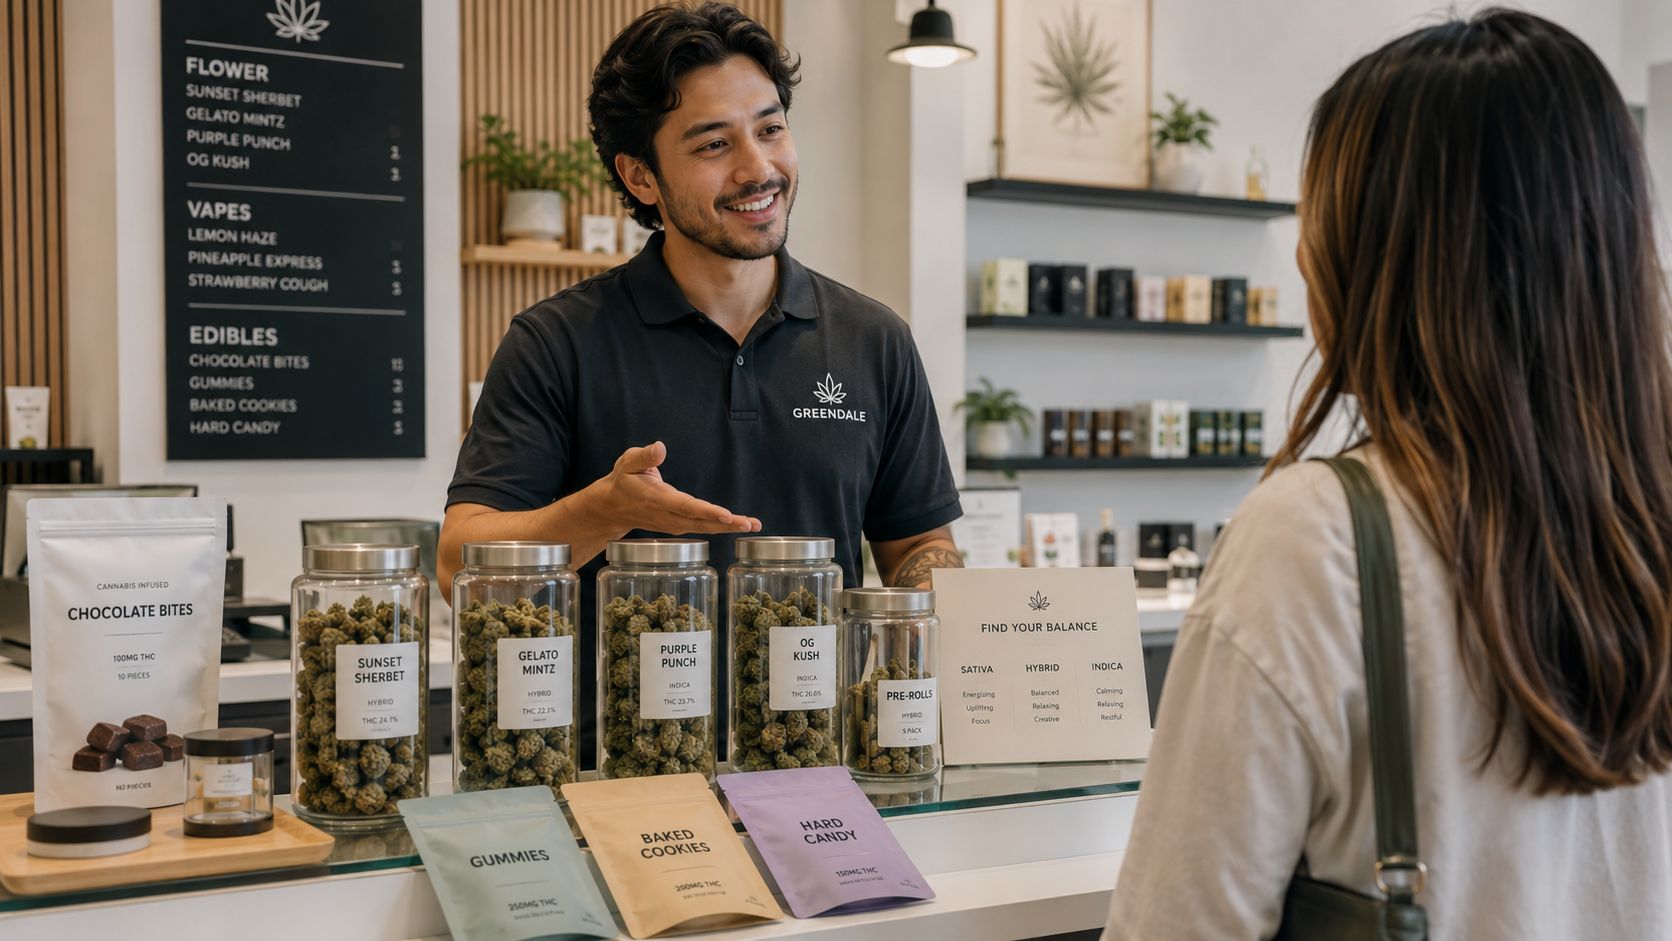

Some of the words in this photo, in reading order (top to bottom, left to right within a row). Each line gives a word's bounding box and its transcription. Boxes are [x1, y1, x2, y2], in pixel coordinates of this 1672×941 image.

[186, 57, 269, 82] FLOWER
[186, 84, 239, 101] SUNSET
[242, 89, 302, 107] SHERBET
[186, 106, 239, 124] GELATO
[243, 113, 285, 128] MINTZ
[187, 130, 239, 146] PURPLE
[243, 134, 291, 150] PUNCH
[187, 152, 209, 167] OG
[212, 155, 250, 169] KUSH
[187, 200, 251, 221] VAPES
[188, 228, 237, 243] LEMON
[241, 231, 277, 246] HAZE
[189, 251, 262, 267] PINEAPPLE
[266, 255, 323, 270] EXPRESS
[188, 274, 276, 290] STRAWBERRY
[280, 277, 328, 292] COUGH
[189, 326, 278, 346] EDIBLES
[189, 354, 270, 368] CHOCOLATE
[274, 355, 309, 369] BITES
[189, 376, 254, 390] GUMMIES
[190, 399, 235, 412] BAKED
[238, 399, 297, 412] COOKIES
[793, 408, 866, 422] GREENDALE
[190, 421, 229, 433] HARD
[232, 421, 281, 434] CANDY
[97, 582, 136, 591] CANNABIS
[138, 580, 169, 589] INFUSED
[68, 604, 156, 621] CHOCOLATE
[159, 602, 193, 617] BITES
[981, 623, 1008, 633] FIND
[1012, 623, 1042, 632] YOUR
[1047, 621, 1098, 632] BALANCE
[660, 643, 697, 655] PURPLE
[800, 638, 815, 649] OG
[113, 654, 138, 662] 100MG
[518, 649, 559, 662] GELATO
[793, 650, 820, 661] KUSH
[358, 656, 402, 669] SUNSET
[662, 657, 696, 668] PUNCH
[961, 665, 993, 673] SATIVA
[1026, 664, 1060, 672] HYBRID
[1092, 662, 1123, 670] INDICA
[522, 664, 555, 675] MINTZ
[354, 671, 405, 684] SHERBET
[887, 690, 932, 700] PRE-ROLLS
[800, 818, 843, 832] HARD
[641, 829, 695, 845] BAKED
[803, 831, 857, 845] CANDY
[640, 842, 711, 859] COOKIES
[470, 849, 550, 868] GUMMIES
[836, 869, 862, 877] 150MG
[675, 882, 703, 892] 200MG
[508, 900, 538, 911] 250MG
